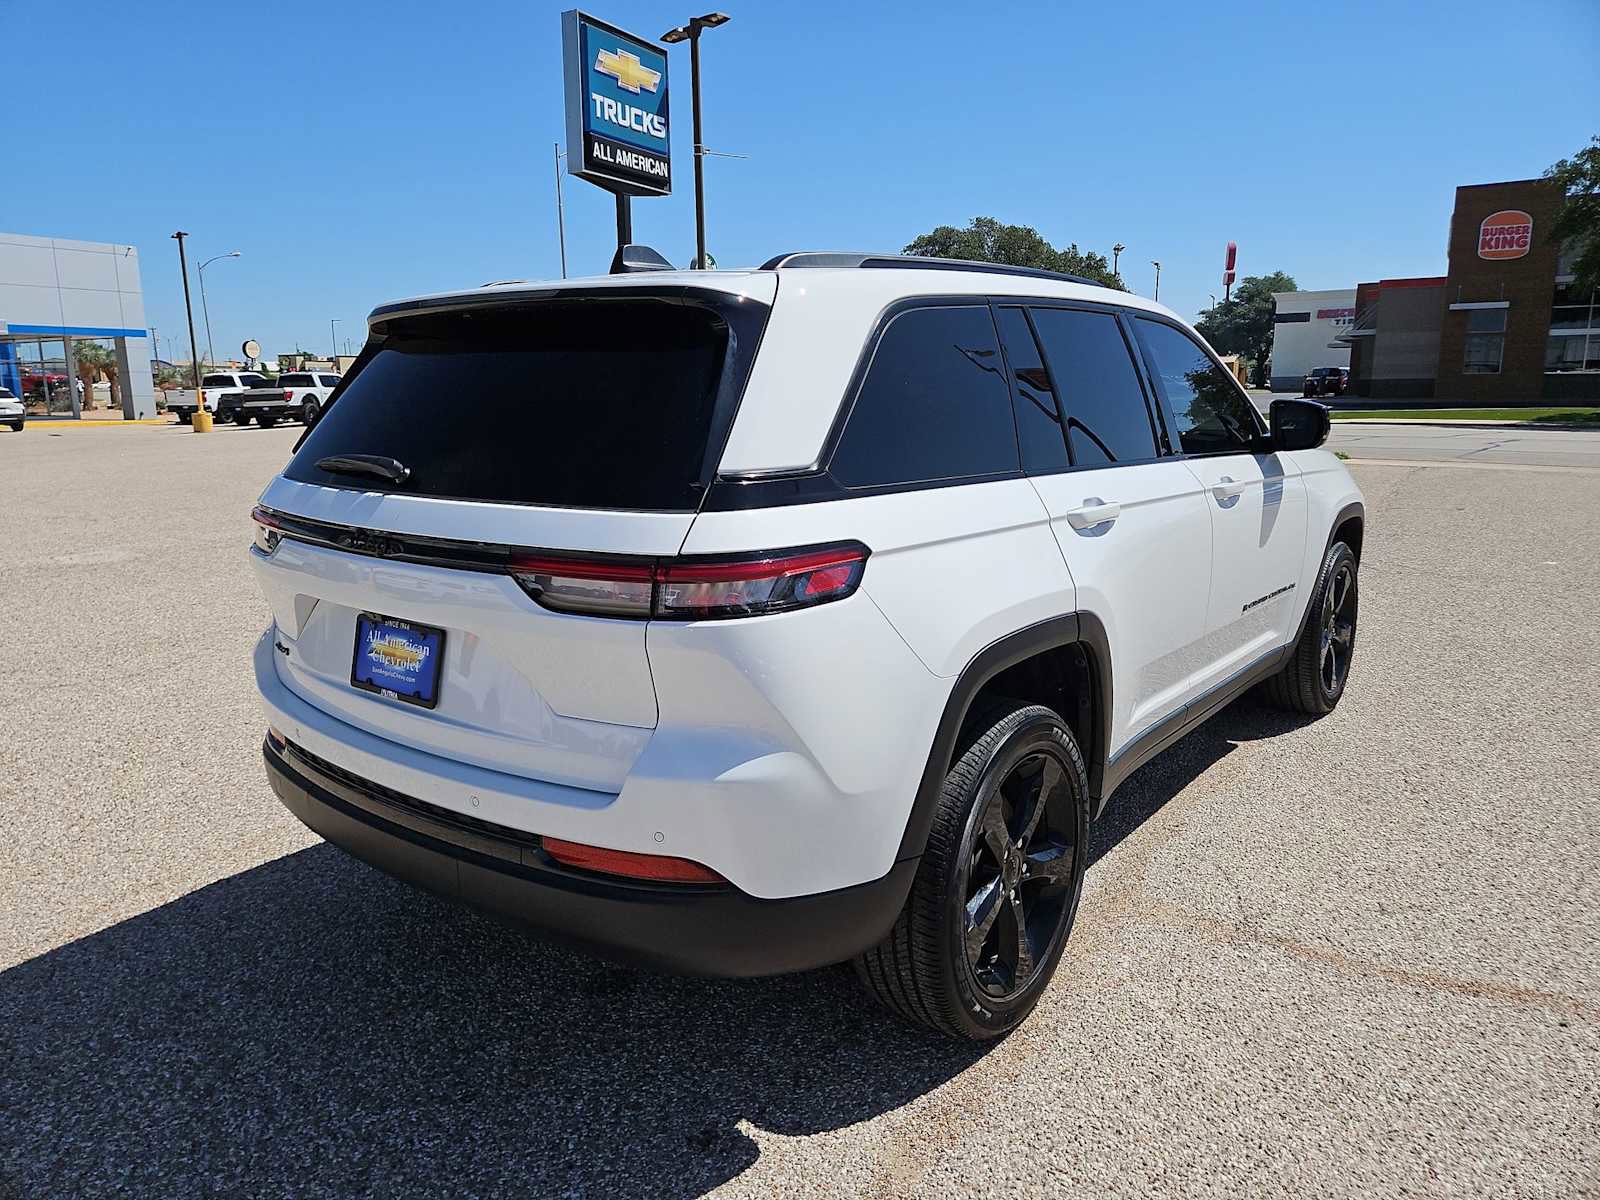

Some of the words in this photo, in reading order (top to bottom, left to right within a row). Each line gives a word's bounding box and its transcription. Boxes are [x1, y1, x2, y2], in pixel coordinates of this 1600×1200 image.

[592, 92, 666, 139] TRUCKS
[593, 142, 615, 162] ALL
[616, 149, 668, 178] AMERICAN
[1480, 235, 1529, 250] KING
[1482, 225, 1530, 237] BURGER
[366, 629, 381, 642] All
[384, 633, 430, 657] American
[372, 649, 420, 673] Chevrolet
